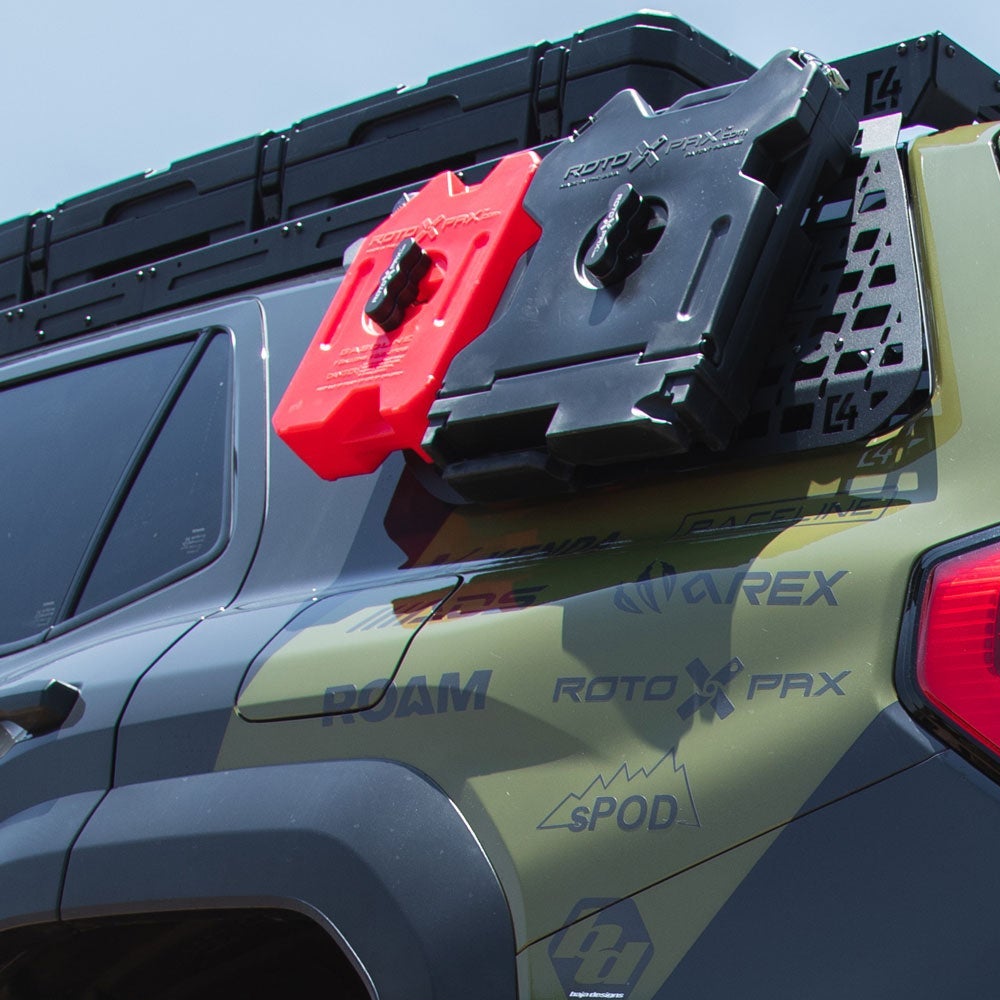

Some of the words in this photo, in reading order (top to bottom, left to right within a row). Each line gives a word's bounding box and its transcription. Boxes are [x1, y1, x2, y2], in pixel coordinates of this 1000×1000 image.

[563, 151, 633, 181] ROTO
[822, 391, 859, 435] C4
[682, 569, 852, 607] AREX
[321, 669, 494, 727] ROAM
[553, 673, 677, 703] ROTO
[747, 670, 852, 699] PAX
[570, 794, 678, 833] sPOD
